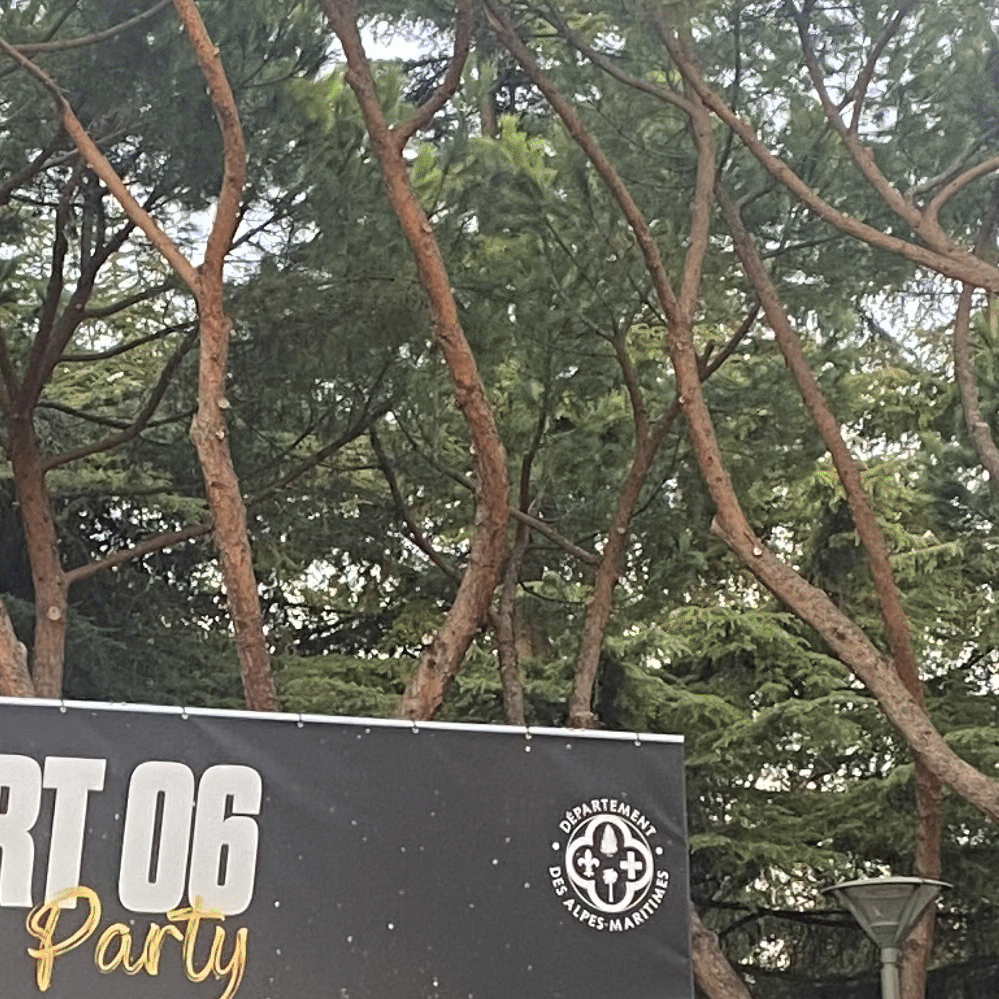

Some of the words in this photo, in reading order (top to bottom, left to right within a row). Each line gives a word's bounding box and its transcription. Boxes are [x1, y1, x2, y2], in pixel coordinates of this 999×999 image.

[559, 798, 657, 837] DÉPARTEMENT
[118, 760, 264, 916] 06
[549, 866, 568, 896] DES
